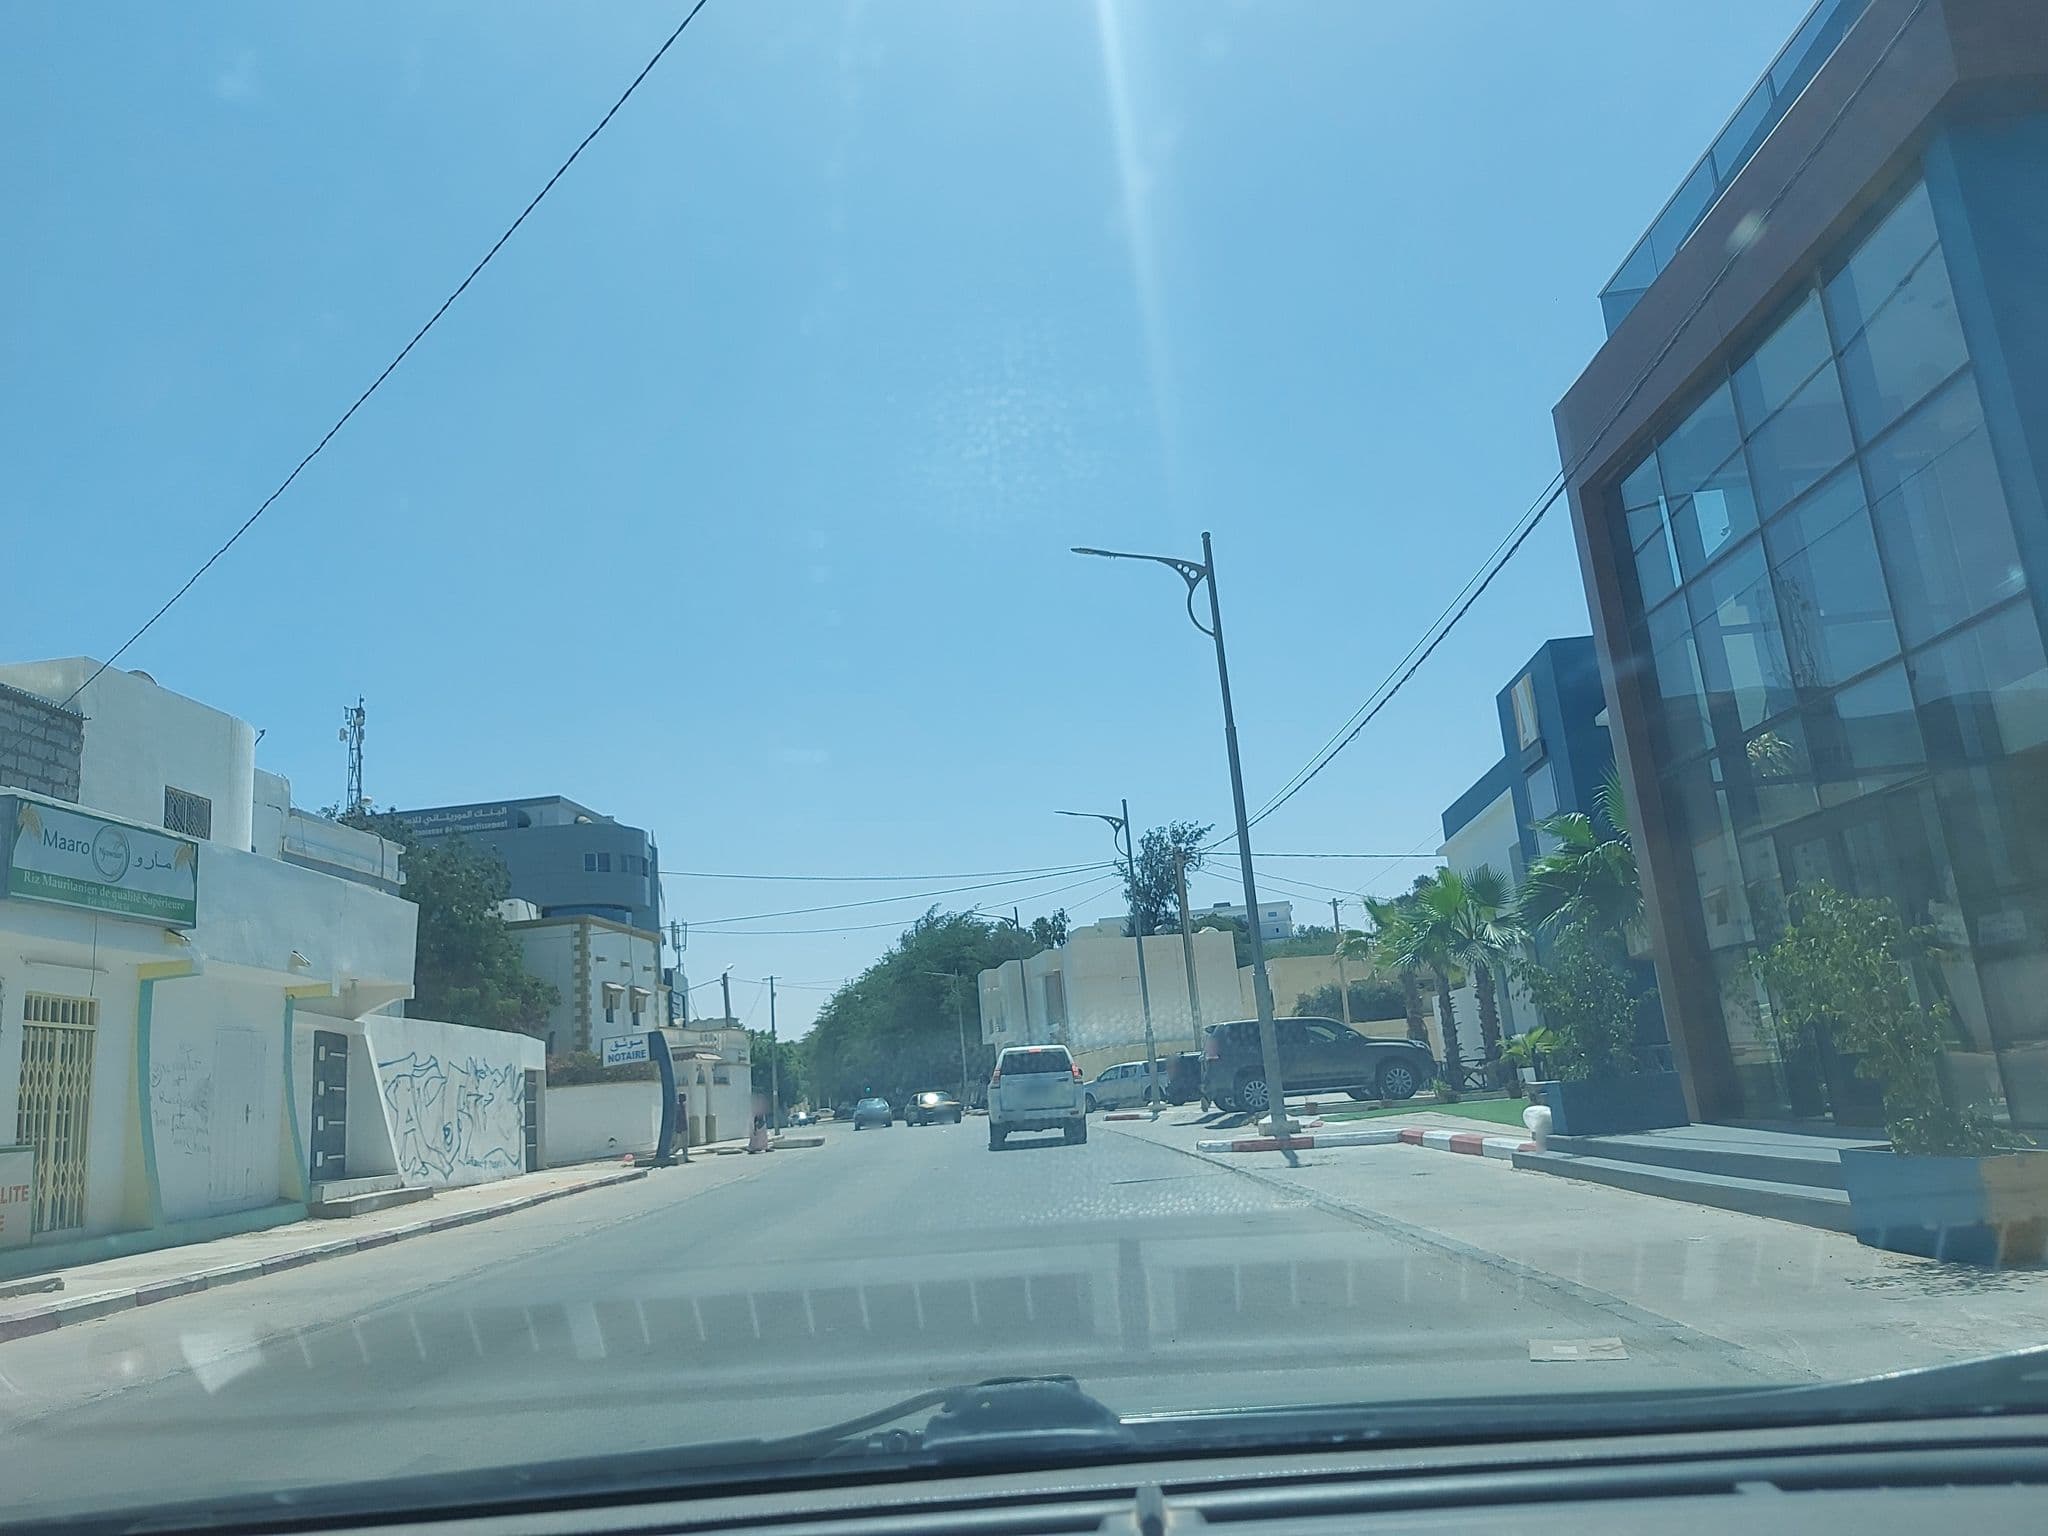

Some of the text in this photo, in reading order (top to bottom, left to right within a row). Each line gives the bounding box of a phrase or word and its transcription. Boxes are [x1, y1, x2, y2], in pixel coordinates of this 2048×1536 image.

[43, 828, 90, 855] Maaro
[23, 870, 41, 885] Riz
[42, 875, 98, 897] Mauritanien
[100, 885, 110, 897] de
[610, 1037, 643, 1052] موثق
[608, 1049, 647, 1063] NOTAIRE
[0, 1185, 29, 1204] LITE
